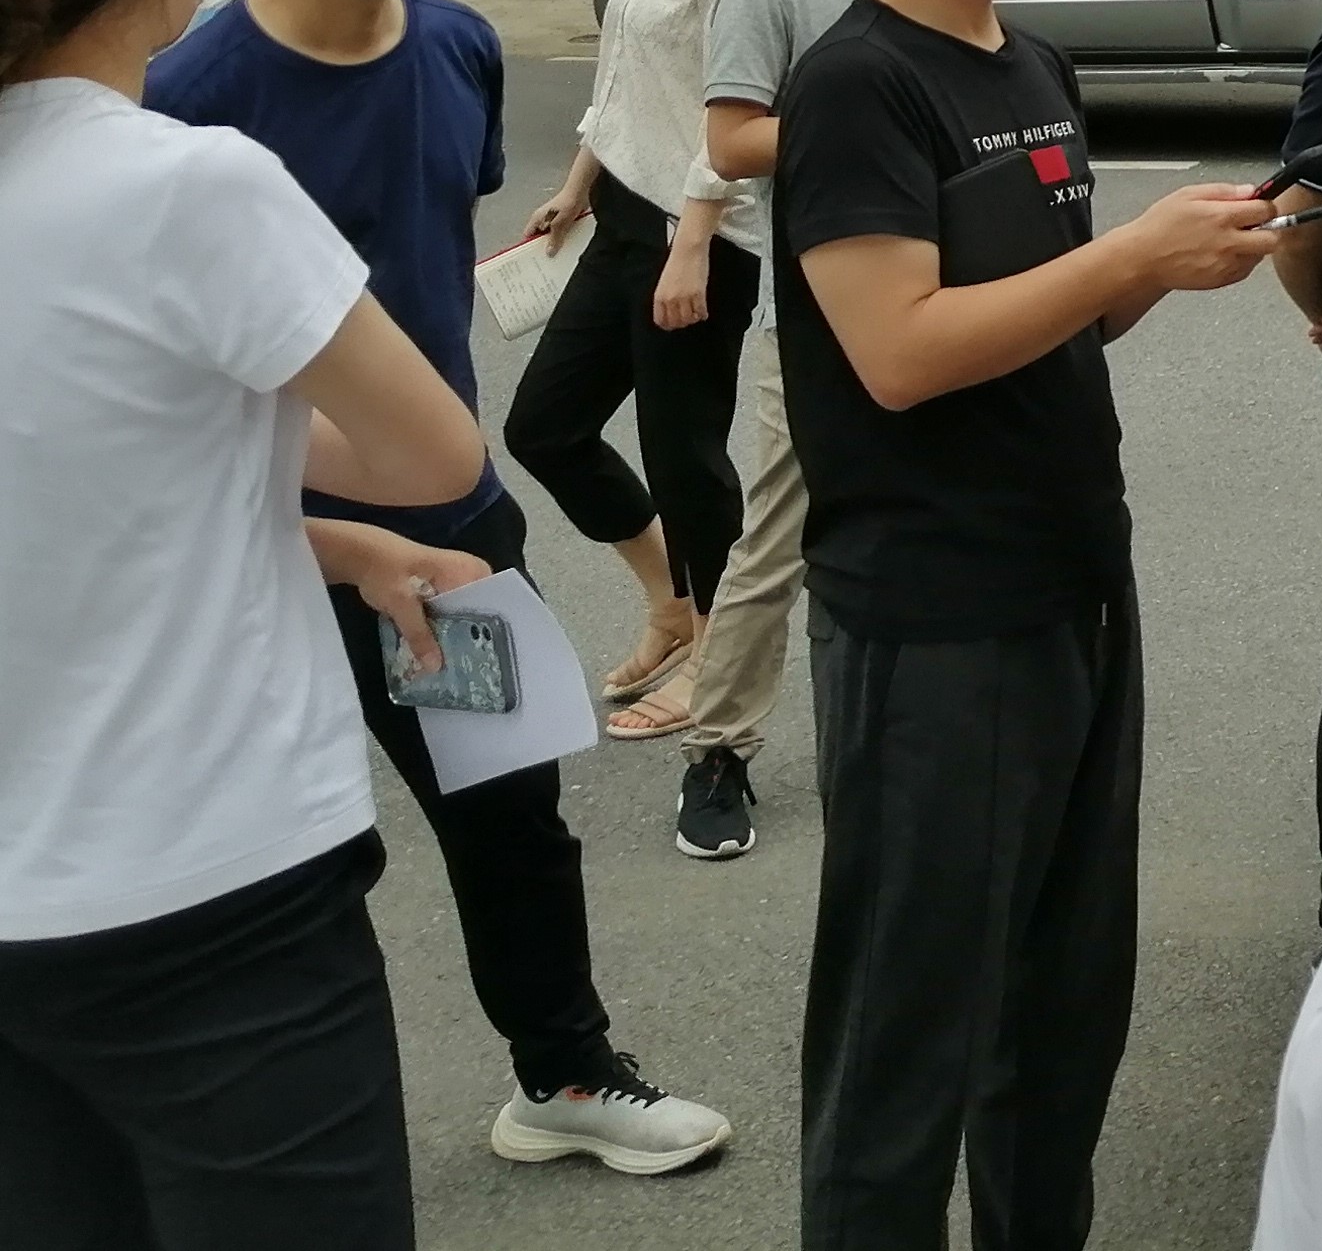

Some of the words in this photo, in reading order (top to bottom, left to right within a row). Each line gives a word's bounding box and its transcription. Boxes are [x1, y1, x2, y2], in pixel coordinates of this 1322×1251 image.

[973, 131, 1018, 153] TOMMY
[1022, 121, 1076, 144] HILFIGER
[1050, 183, 1089, 206] XXIV
